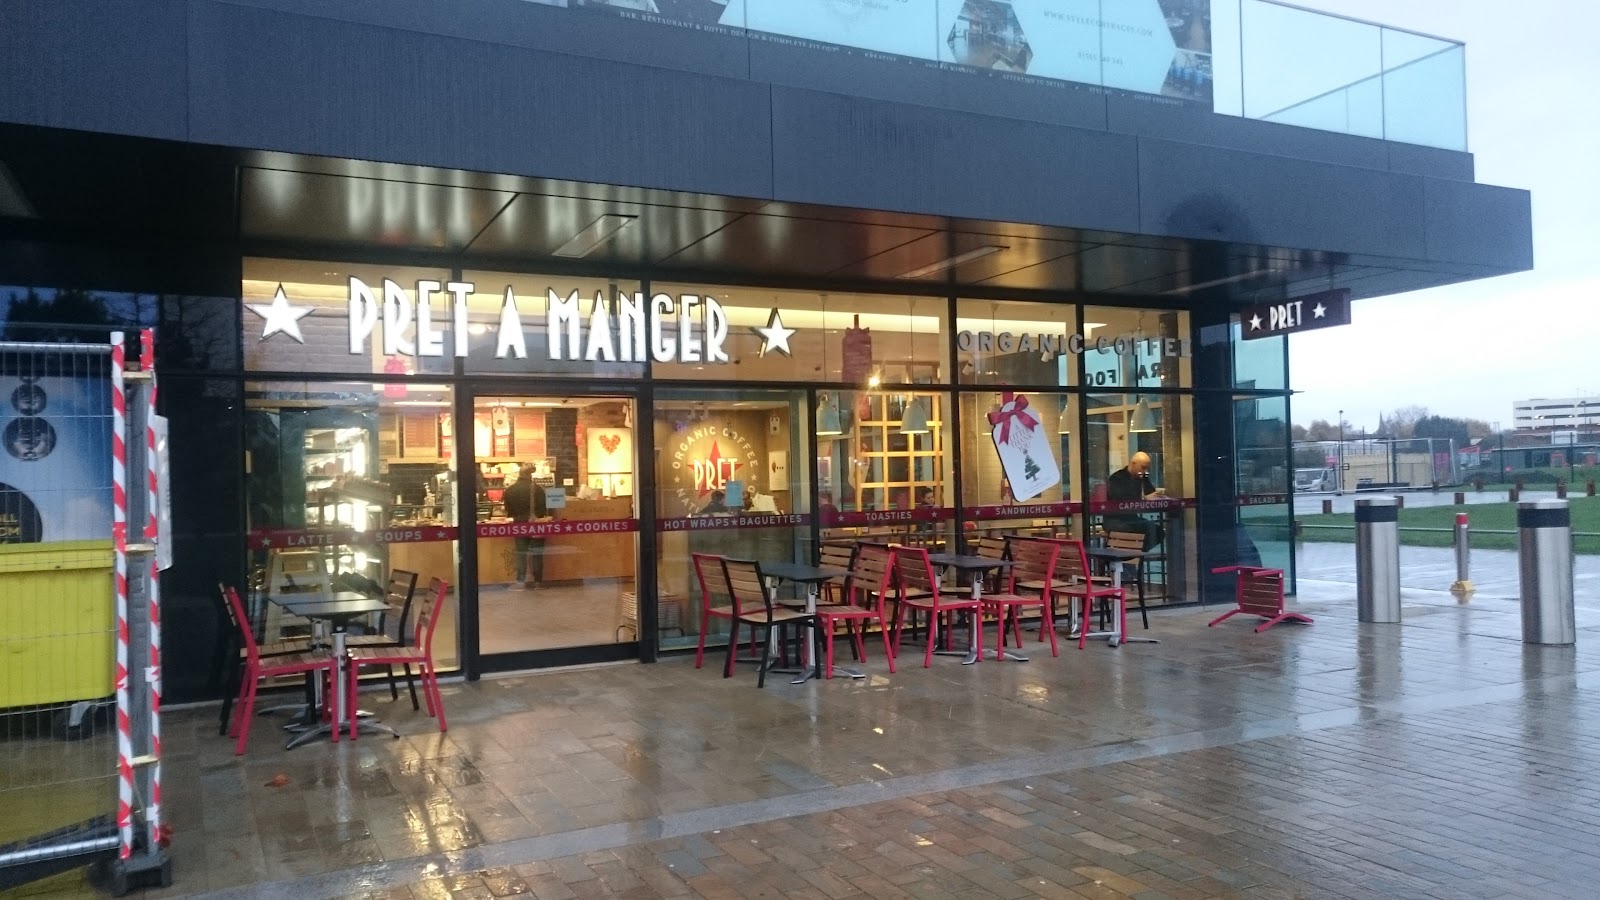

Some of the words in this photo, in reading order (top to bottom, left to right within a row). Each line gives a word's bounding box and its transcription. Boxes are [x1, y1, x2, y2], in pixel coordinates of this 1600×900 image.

[641, 14, 693, 29] RESTAURANT
[703, 25, 727, 35] HOTEL
[730, 29, 759, 41] DESIGN
[769, 36, 806, 48] COMPLETE
[346, 275, 475, 355] PRET
[495, 285, 528, 359] A
[547, 287, 729, 364] MANGER
[1269, 300, 1303, 331] PRET
[957, 330, 1084, 354] ORGANIC
[1096, 336, 1192, 357] COFFEE
[672, 426, 716, 470] ORGANIC
[1010, 433, 1034, 449] THANK
[1017, 441, 1031, 452] YOU
[694, 458, 738, 491] PRET
[1118, 500, 1169, 510] CAPPUCCINO
[1249, 496, 1275, 504] SALADS
[865, 511, 912, 521] TOASTIES
[995, 505, 1052, 516] SANDWICHES
[480, 523, 561, 536] CROISSANTS
[576, 521, 629, 532] COOKIES
[664, 520, 686, 529] HOT
[690, 518, 729, 528] WRAPS
[739, 514, 802, 526] BAGUETTES
[287, 534, 334, 546] LATTE
[375, 530, 422, 542] SOUPS
